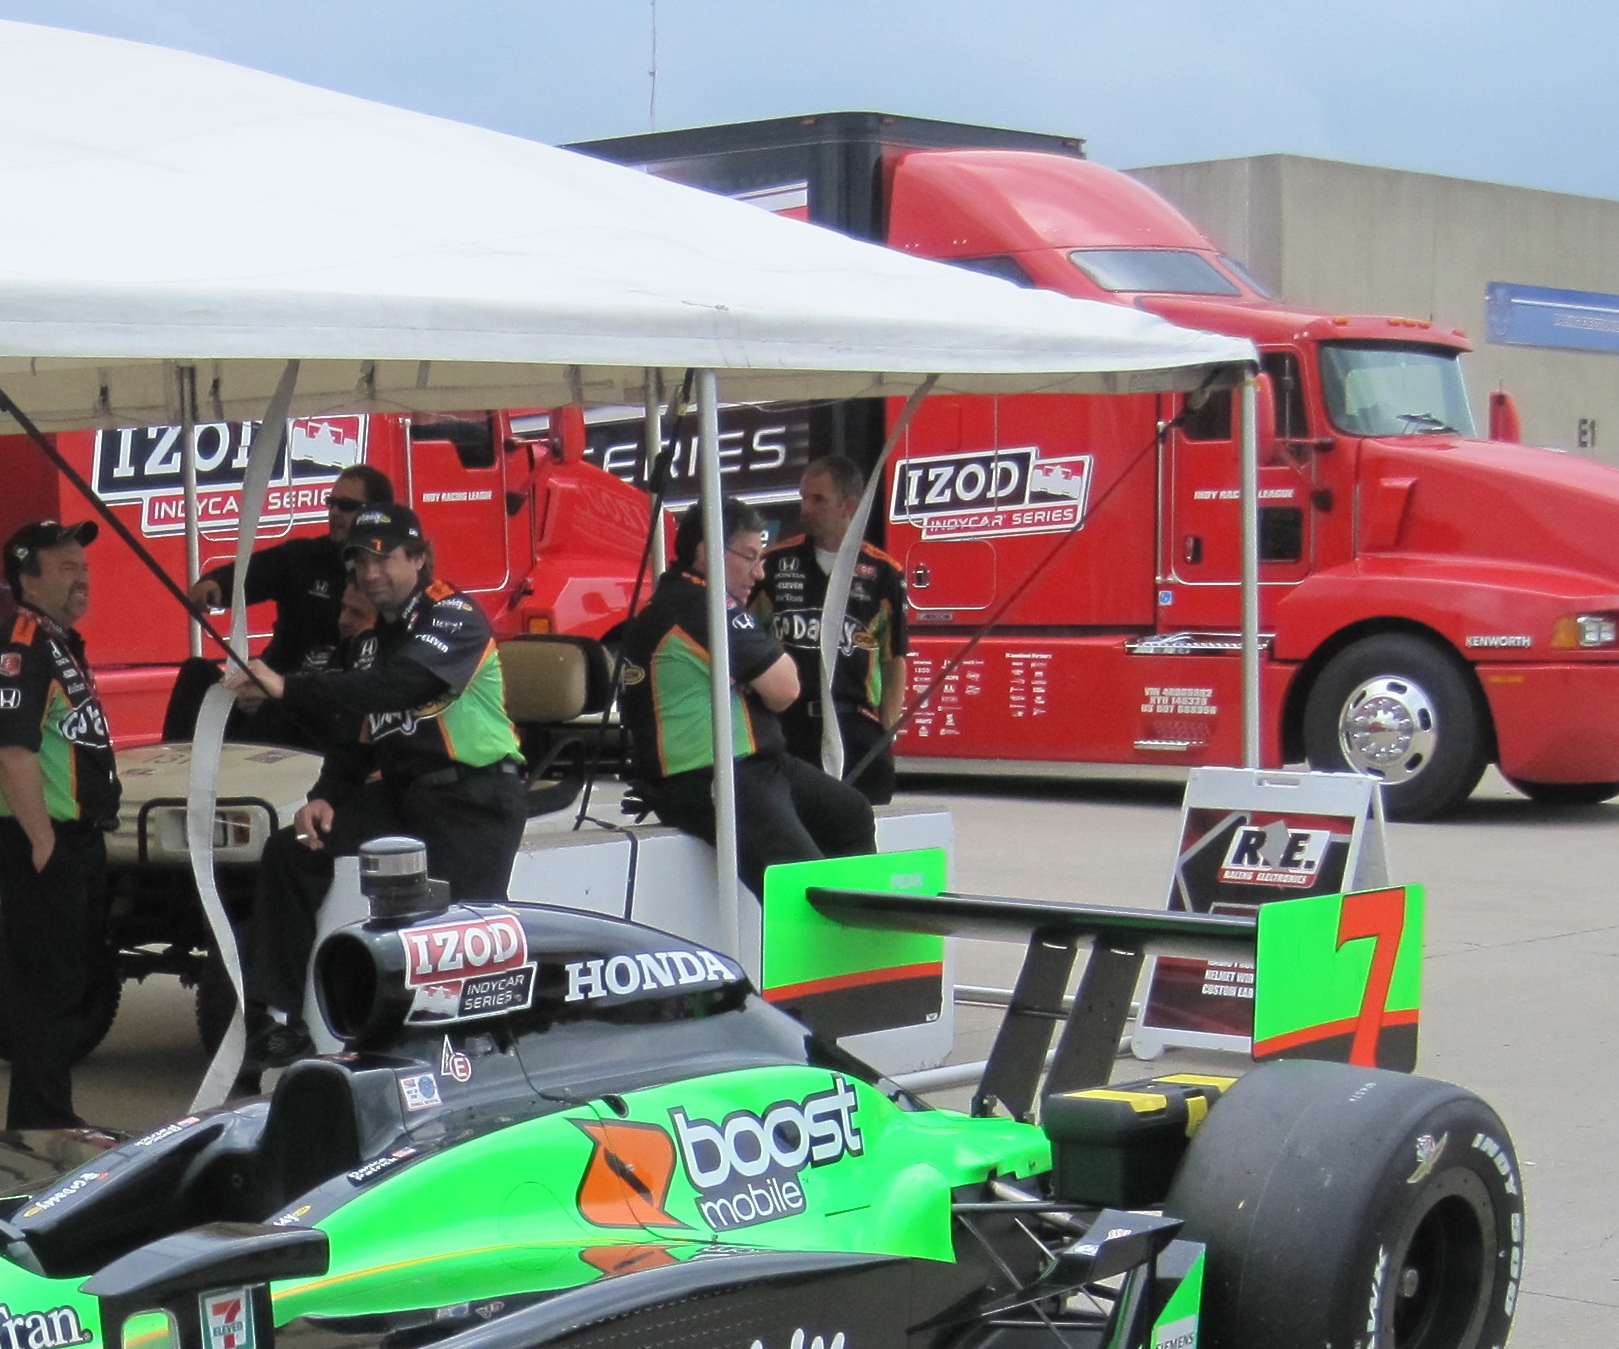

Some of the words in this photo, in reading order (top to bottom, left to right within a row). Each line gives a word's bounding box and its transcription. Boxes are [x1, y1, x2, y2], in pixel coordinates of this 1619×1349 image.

[268, 487, 333, 511] SERIE
[904, 461, 1020, 506] IZOD
[1219, 490, 1240, 499] RAC
[930, 515, 1003, 532] INDYCAR
[1012, 508, 1074, 525] SERIES
[1465, 636, 1531, 648] KENWORTH
[411, 922, 518, 976] IZOD
[466, 974, 525, 995] INDYCAR
[564, 950, 736, 1002] HONDA
[1336, 886, 1406, 1068] 7
[464, 990, 513, 1011] SERIES
[672, 1074, 863, 1189] boost
[700, 1176, 803, 1229] mobile
